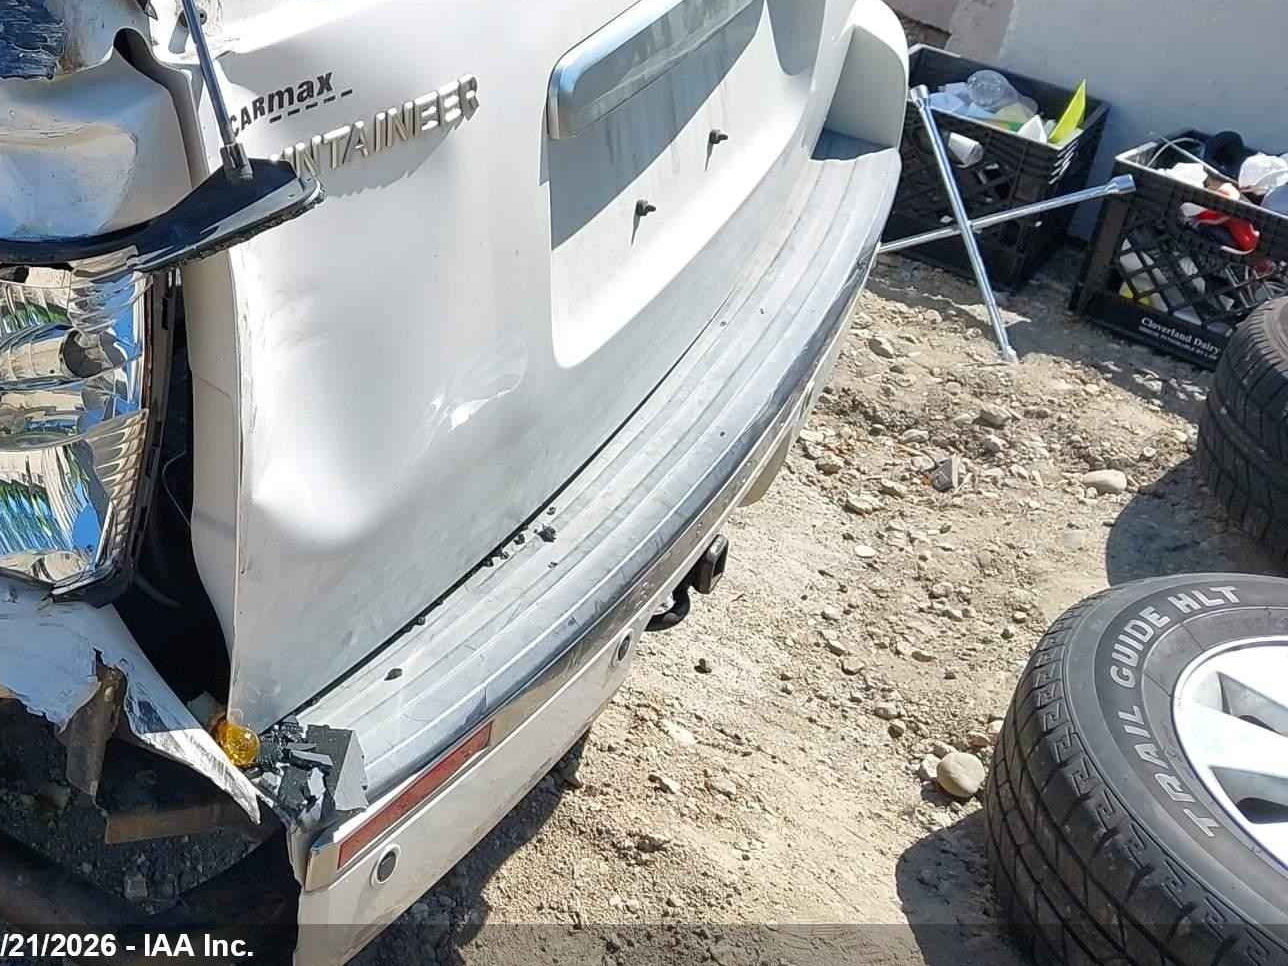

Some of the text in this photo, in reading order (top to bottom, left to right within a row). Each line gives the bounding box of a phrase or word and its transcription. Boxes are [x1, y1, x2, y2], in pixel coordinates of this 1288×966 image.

[270, 73, 480, 177] NTAINEER
[1140, 316, 1192, 343] Cloverland
[1193, 337, 1221, 355] Dairy
[1110, 585, 1241, 838] TRAIL GUIDE HLT
